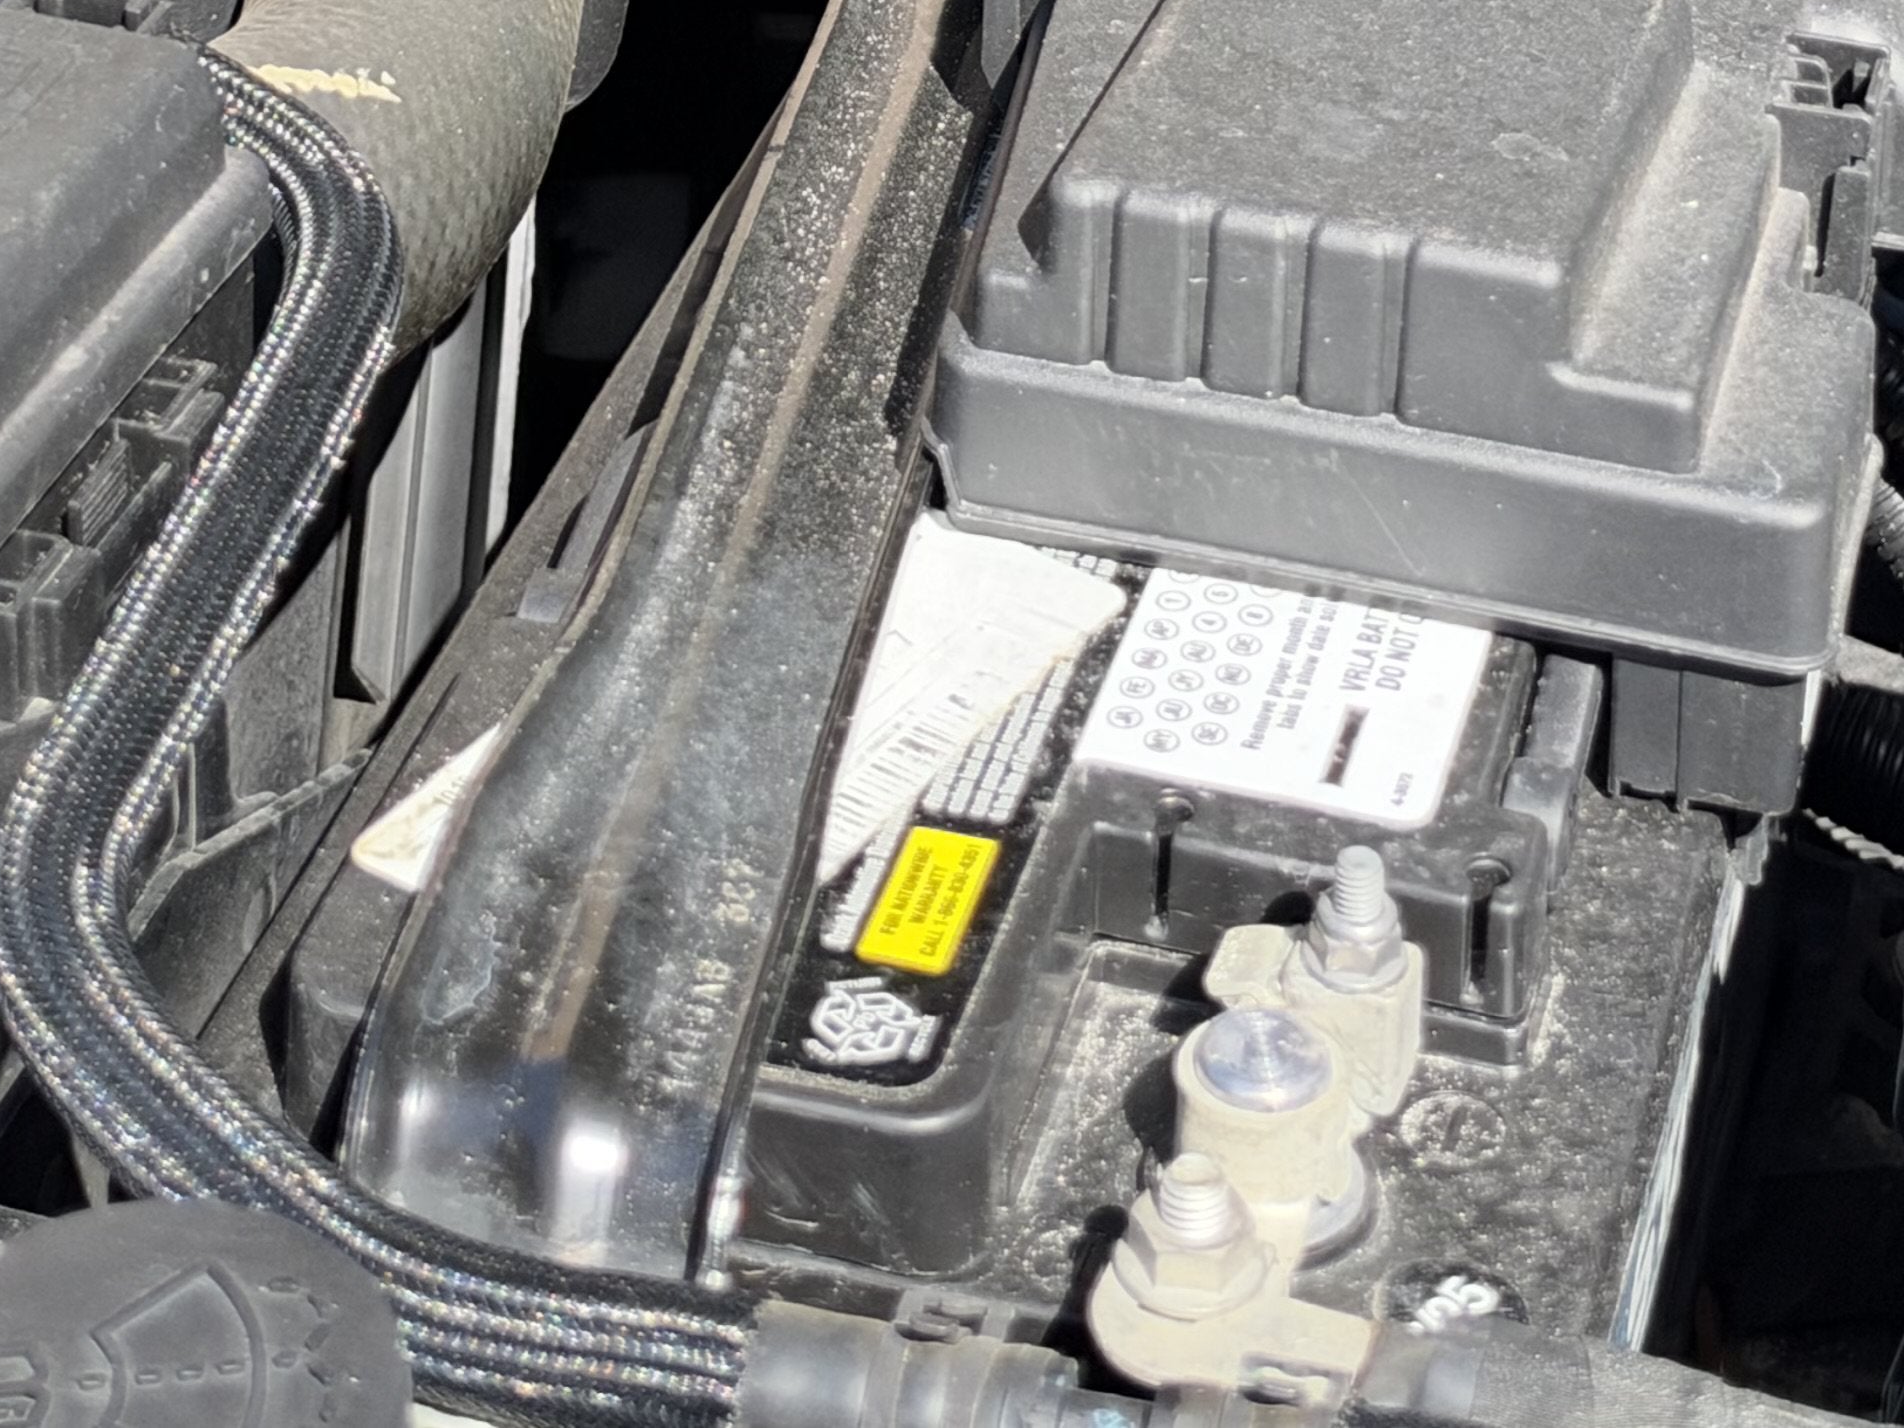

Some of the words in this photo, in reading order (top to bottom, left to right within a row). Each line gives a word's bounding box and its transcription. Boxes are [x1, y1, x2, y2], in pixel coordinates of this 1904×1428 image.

[1307, 624, 1332, 652] date
[1356, 607, 1390, 645] BAT
[1384, 626, 1420, 663] NOT
[1240, 699, 1277, 750] Remove
[1265, 656, 1293, 698] proper
[1281, 616, 1309, 656] month
[1295, 654, 1321, 686] show
[1338, 647, 1378, 692] VRLA
[1374, 664, 1407, 692] DO
[1286, 687, 1308, 701] to
[1276, 703, 1303, 730] tabs
[879, 907, 903, 936] FOR
[895, 844, 934, 912] NATIONWIDE
[907, 864, 950, 925] WARRANTY
[919, 929, 946, 958] CALL
